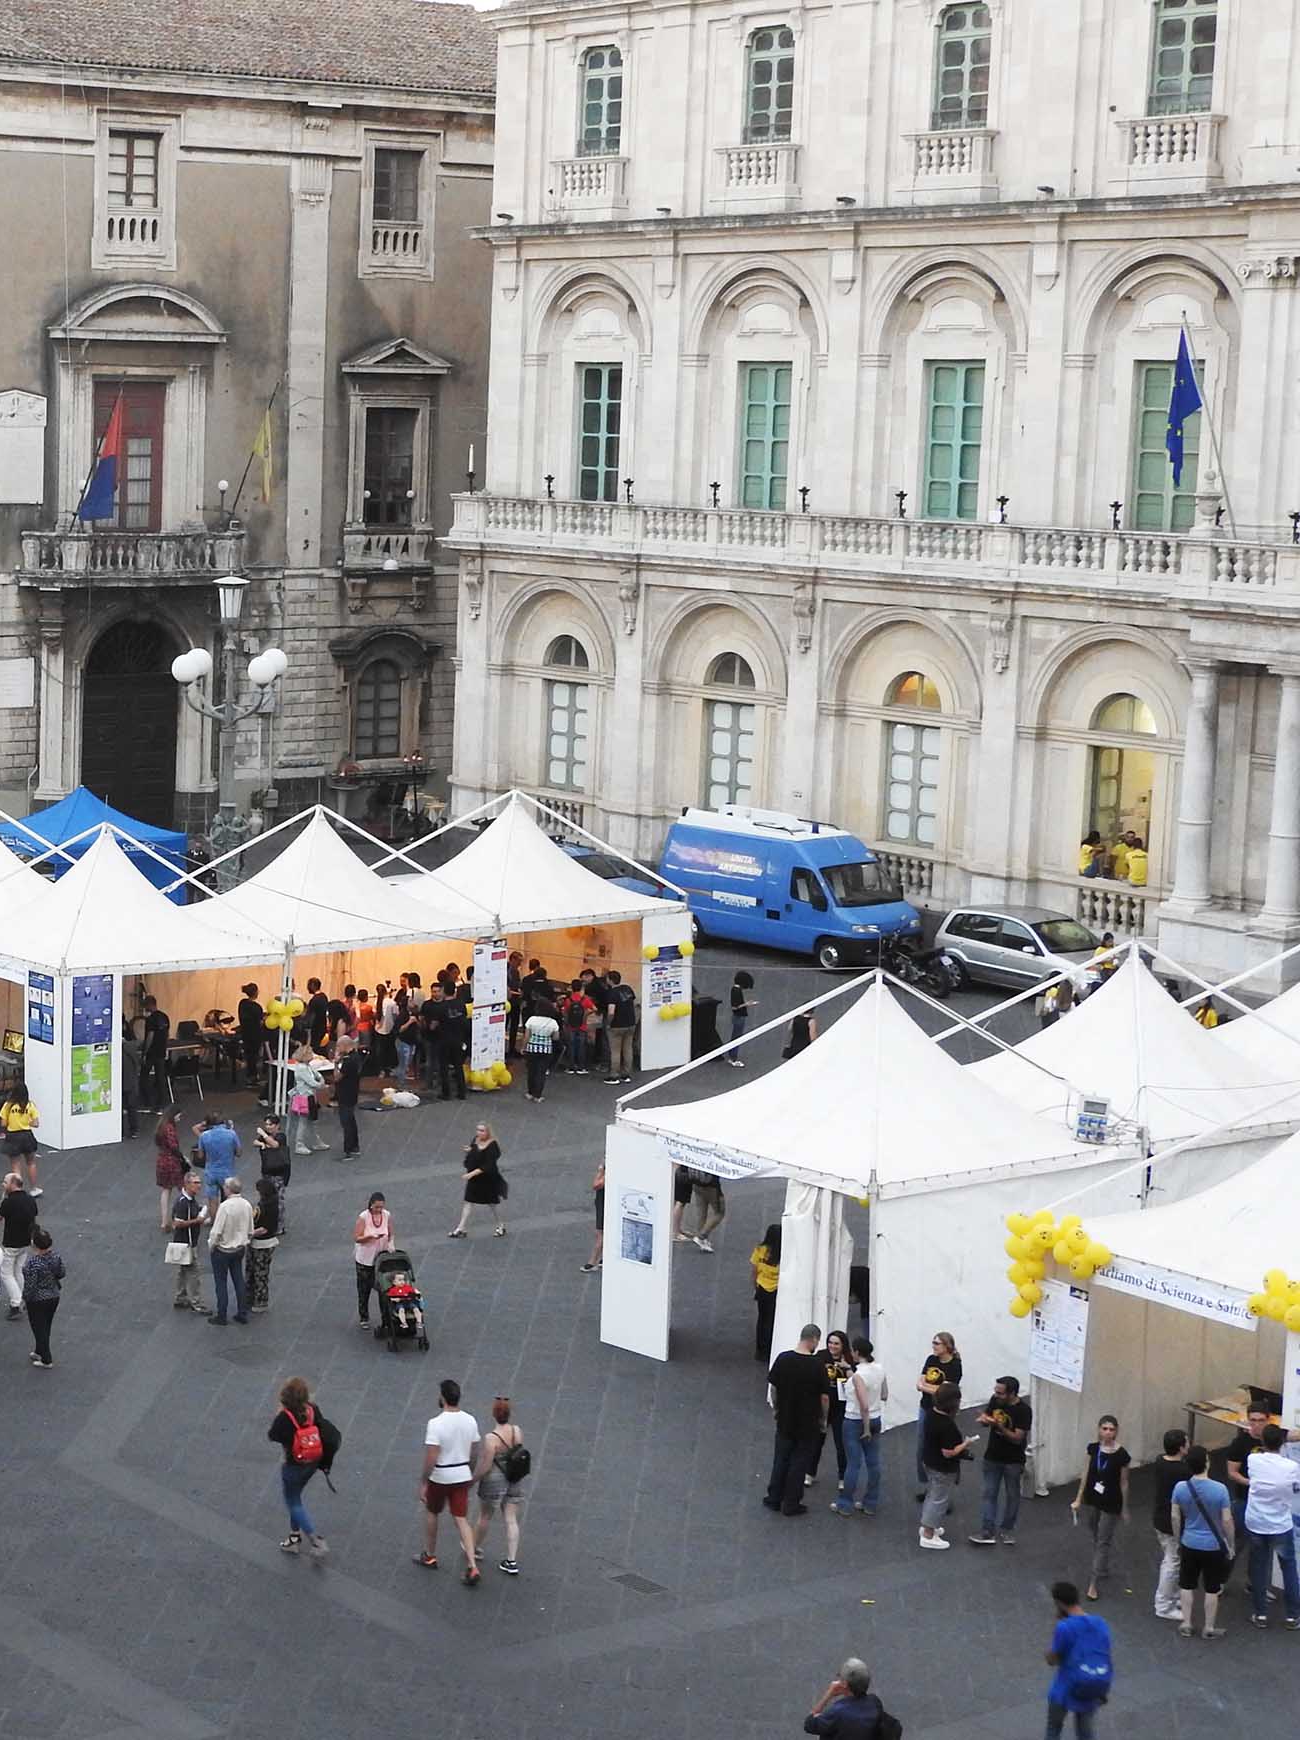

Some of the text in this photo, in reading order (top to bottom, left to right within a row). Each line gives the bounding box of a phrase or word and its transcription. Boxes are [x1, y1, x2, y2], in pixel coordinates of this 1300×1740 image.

[1092, 1264, 1253, 1320] Parliamo di Scienza e Salute
